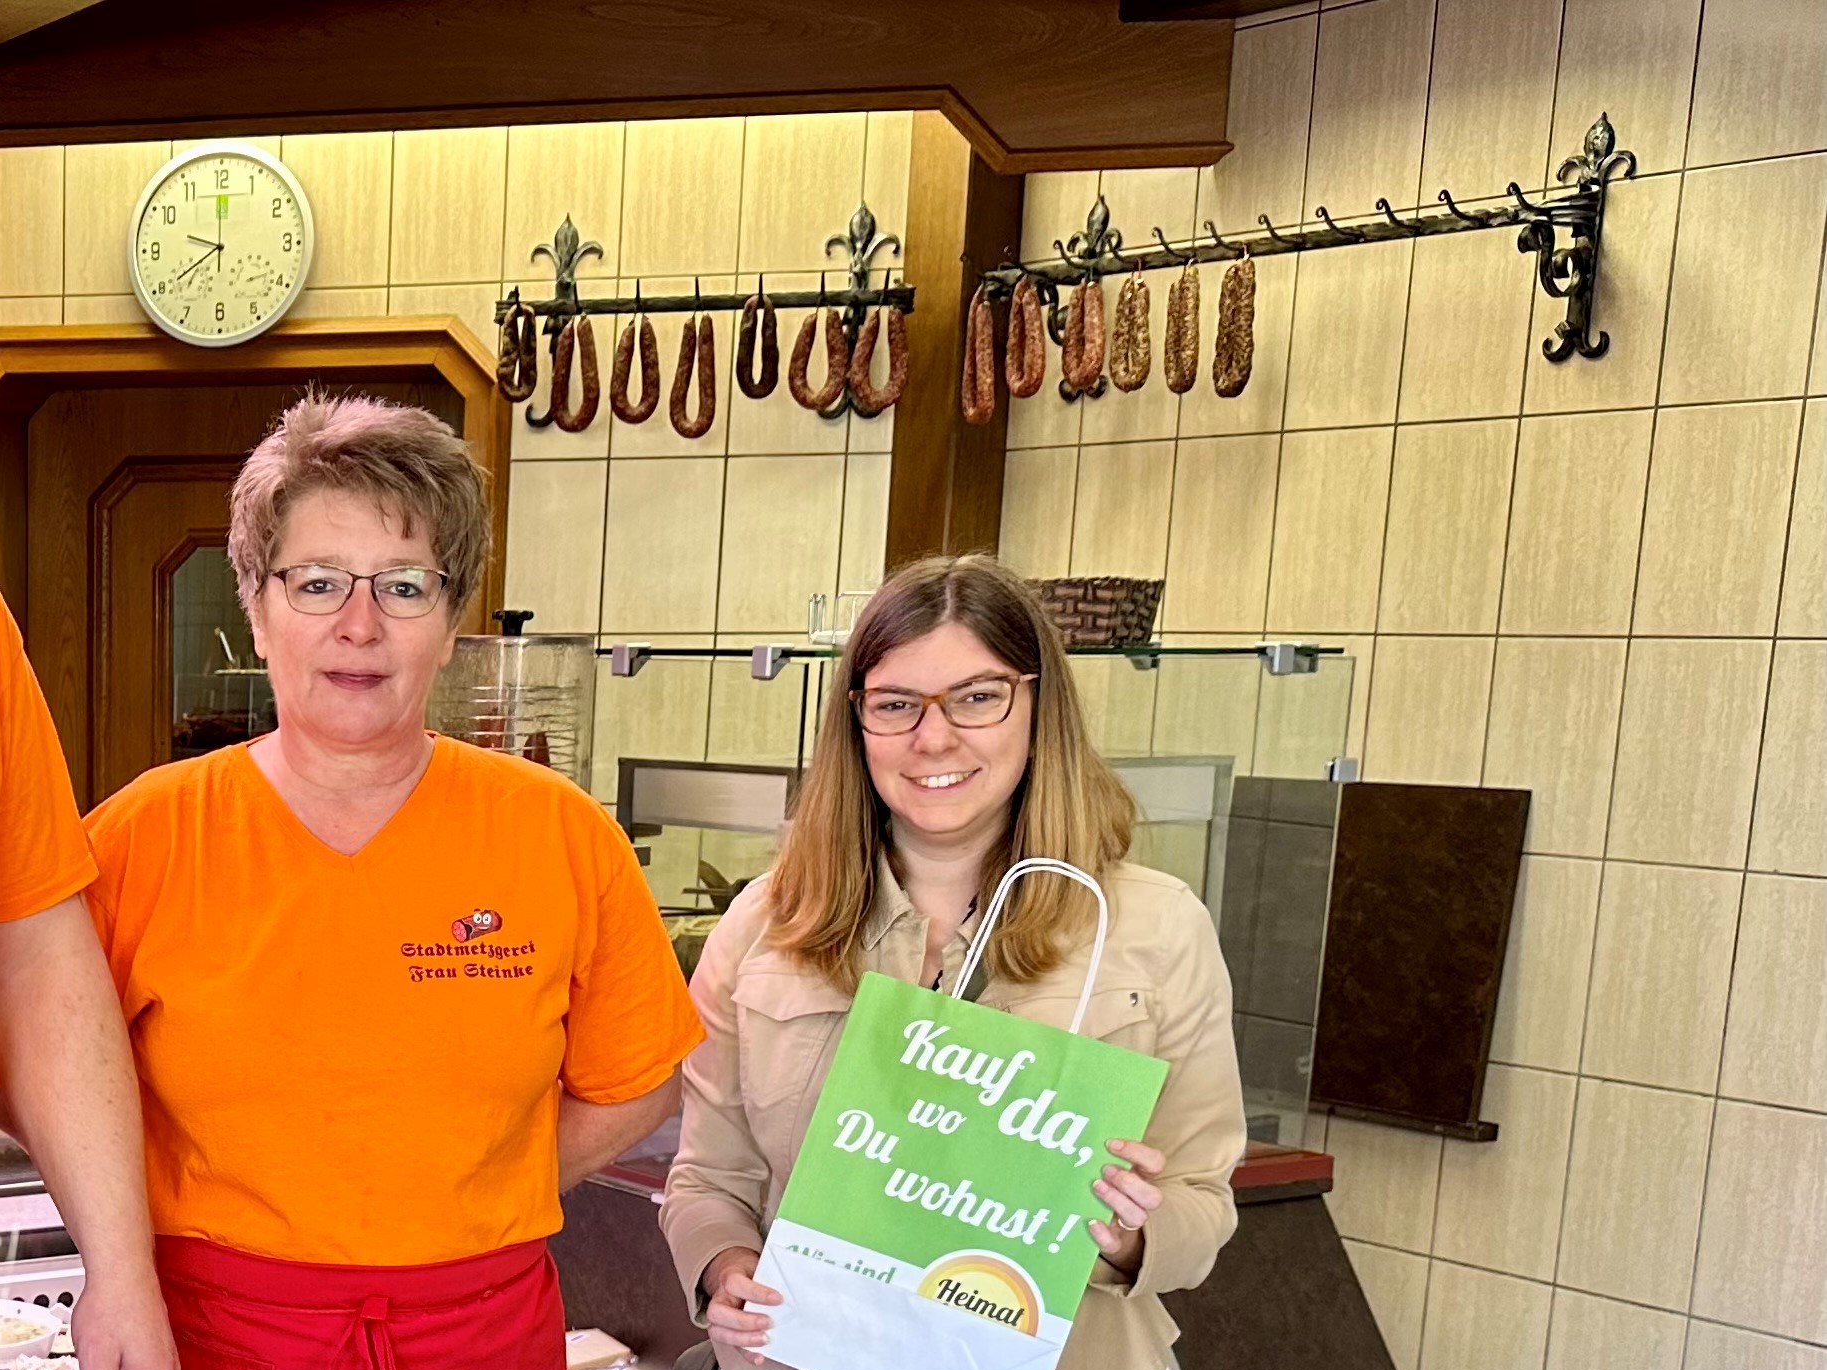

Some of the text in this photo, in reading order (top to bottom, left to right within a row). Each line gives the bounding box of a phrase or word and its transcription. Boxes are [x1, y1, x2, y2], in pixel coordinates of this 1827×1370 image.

[214, 169, 230, 190] 12
[249, 175, 255, 195] 1
[183, 181, 196, 202] 11
[161, 204, 176, 225] 10
[272, 198, 282, 218] 2
[150, 241, 160, 261] 9
[282, 232, 292, 252] 3
[157, 280, 166, 294] 8
[276, 273, 283, 287] 4
[183, 305, 191, 320] 7
[215, 302, 225, 321] 6
[400, 939, 536, 960] Stadtmetzgerei
[408, 963, 534, 983] Frau Steinke
[899, 1019, 1094, 1169] Kauf da,
[907, 1097, 967, 1135] wo
[832, 1109, 900, 1165] Du
[884, 1167, 1049, 1246] wohnst
[938, 1278, 1025, 1327] Heimat
